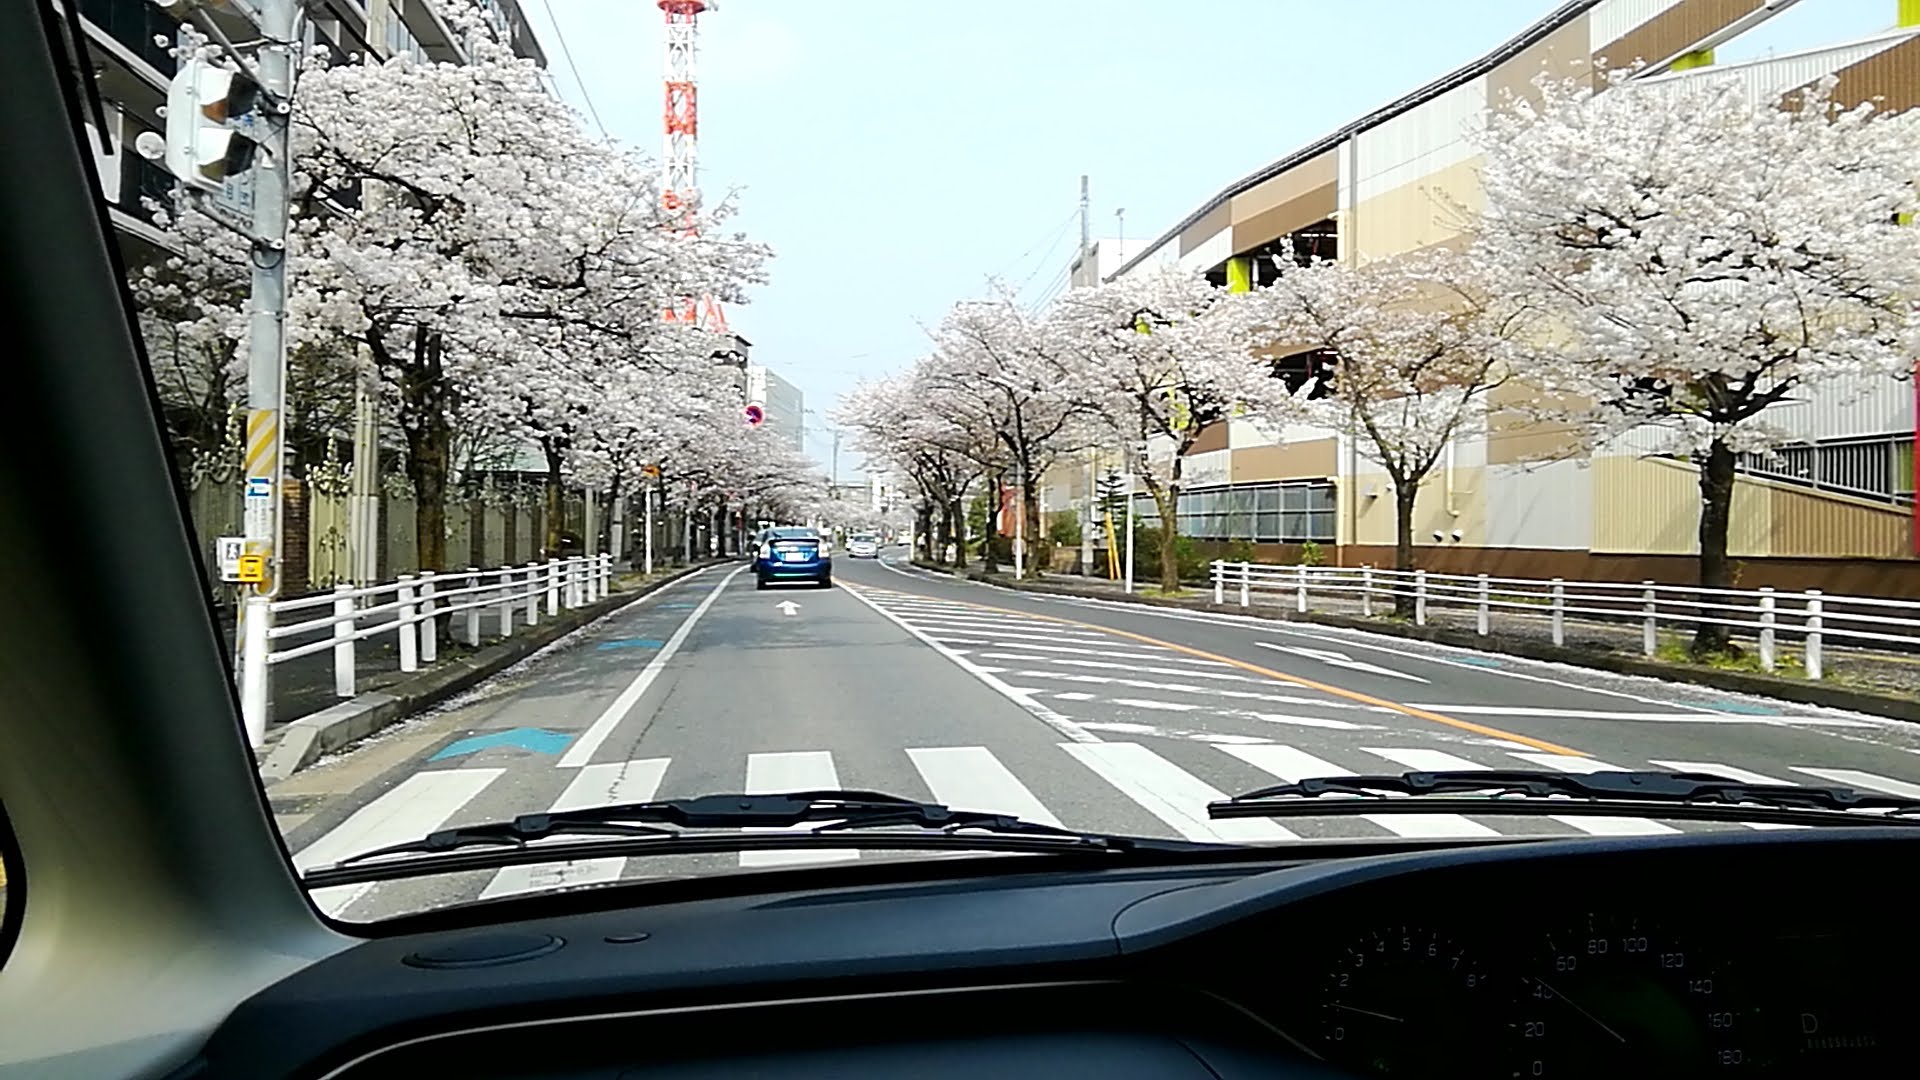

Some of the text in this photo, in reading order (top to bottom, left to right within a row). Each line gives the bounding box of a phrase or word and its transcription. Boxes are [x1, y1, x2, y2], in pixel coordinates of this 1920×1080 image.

[1375, 941, 1385, 952] 4
[1402, 937, 1411, 951] 5
[1428, 943, 1437, 957] 6
[1588, 938, 1608, 954] 80
[1623, 937, 1648, 953] 100
[1355, 953, 1364, 967] 3
[1451, 957, 1460, 970] 7
[1557, 955, 1577, 971] 60
[1660, 952, 1684, 968] 120
[1339, 973, 1349, 987] 2
[1466, 974, 1476, 987] 8
[1689, 979, 1712, 994] 140
[1708, 1012, 1732, 1028] 160
[1801, 1012, 1818, 1034] D
[1335, 1027, 1345, 1041] 0
[1525, 1021, 1544, 1037] 20
[1718, 1049, 1743, 1065] 180
[1533, 1060, 1542, 1076] 0
